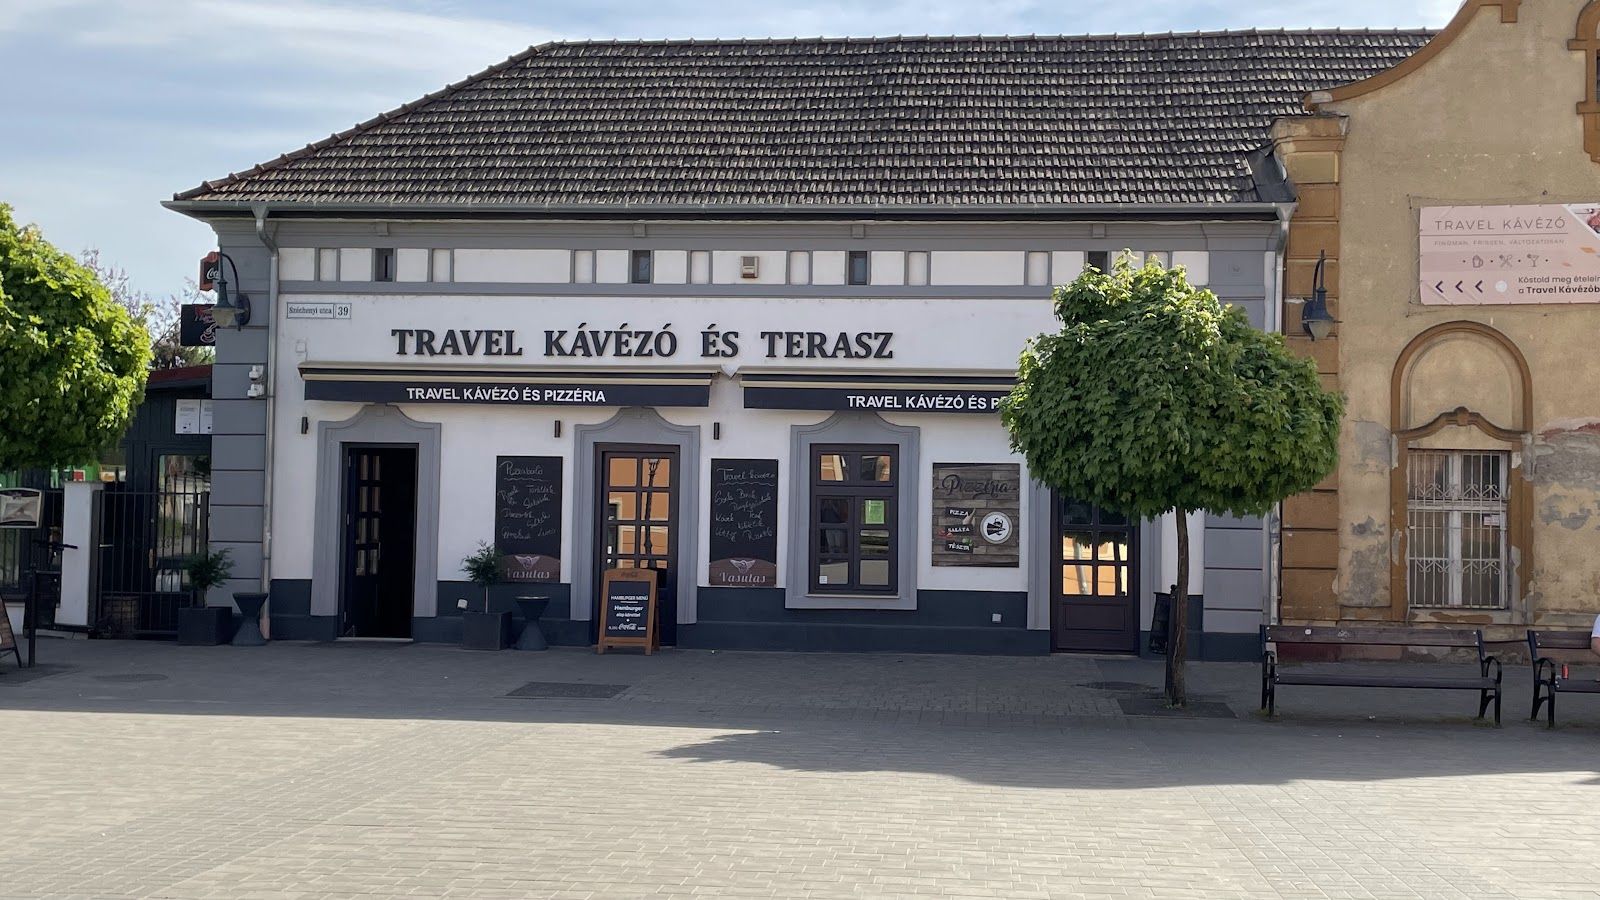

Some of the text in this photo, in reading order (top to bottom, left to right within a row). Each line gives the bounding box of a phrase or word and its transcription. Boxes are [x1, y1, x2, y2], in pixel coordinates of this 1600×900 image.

[1434, 216, 1566, 230] TRAVEL KÁVÉZÓ
[1518, 276, 1550, 284] Kóstold
[1552, 277, 1572, 285] meg
[1526, 286, 1557, 294] Travel
[289, 306, 318, 315] Széchenyi
[337, 306, 349, 316] 39
[391, 323, 893, 359] TRAVEL KÁVÉZÓ ÉS TERASZ
[406, 386, 606, 403] TRAVEL KÁVÉZÓ ÉS PIZZÉRIA
[847, 395, 902, 408] TRAVEL
[905, 394, 964, 409] KÁVÉZÓ
[968, 395, 987, 410] ÉS
[720, 571, 766, 583] Vasutas
